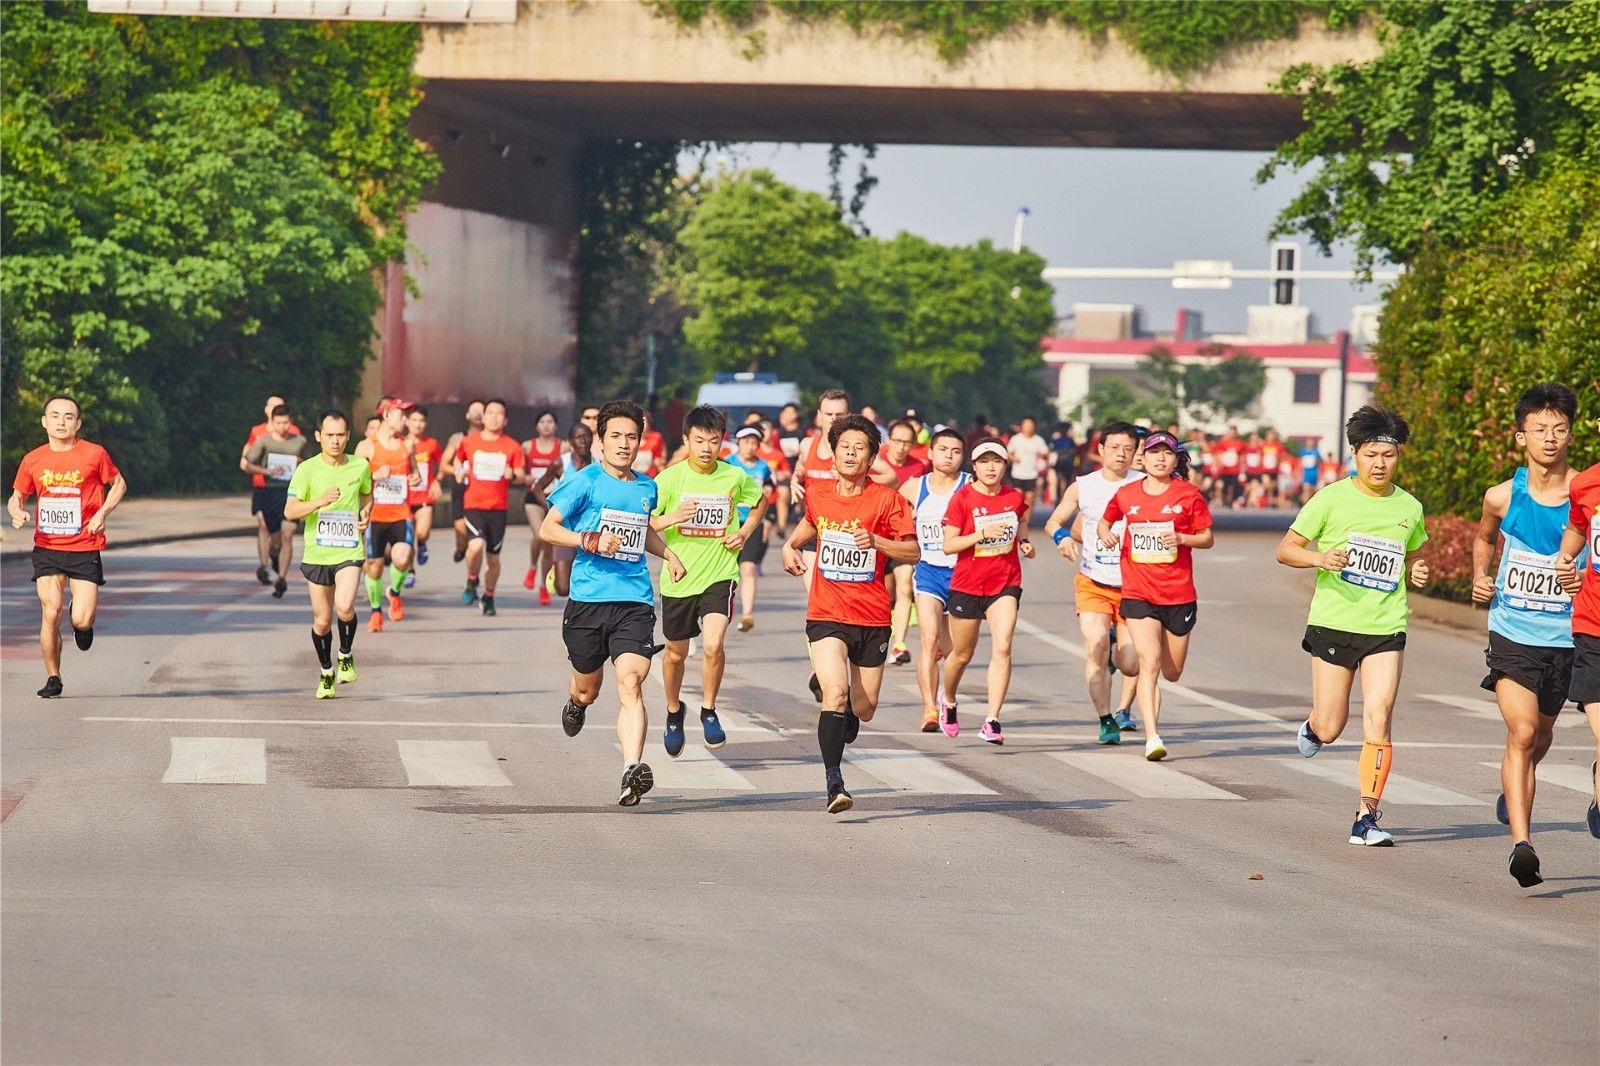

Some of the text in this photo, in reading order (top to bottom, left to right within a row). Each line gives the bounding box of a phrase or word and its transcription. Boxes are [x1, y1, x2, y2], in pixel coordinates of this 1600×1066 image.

[40, 508, 74, 524] C10691
[318, 520, 354, 536] C10008
[821, 545, 868, 568] C10497
[1348, 547, 1395, 577] C10061
[1507, 567, 1563, 596] C10218
